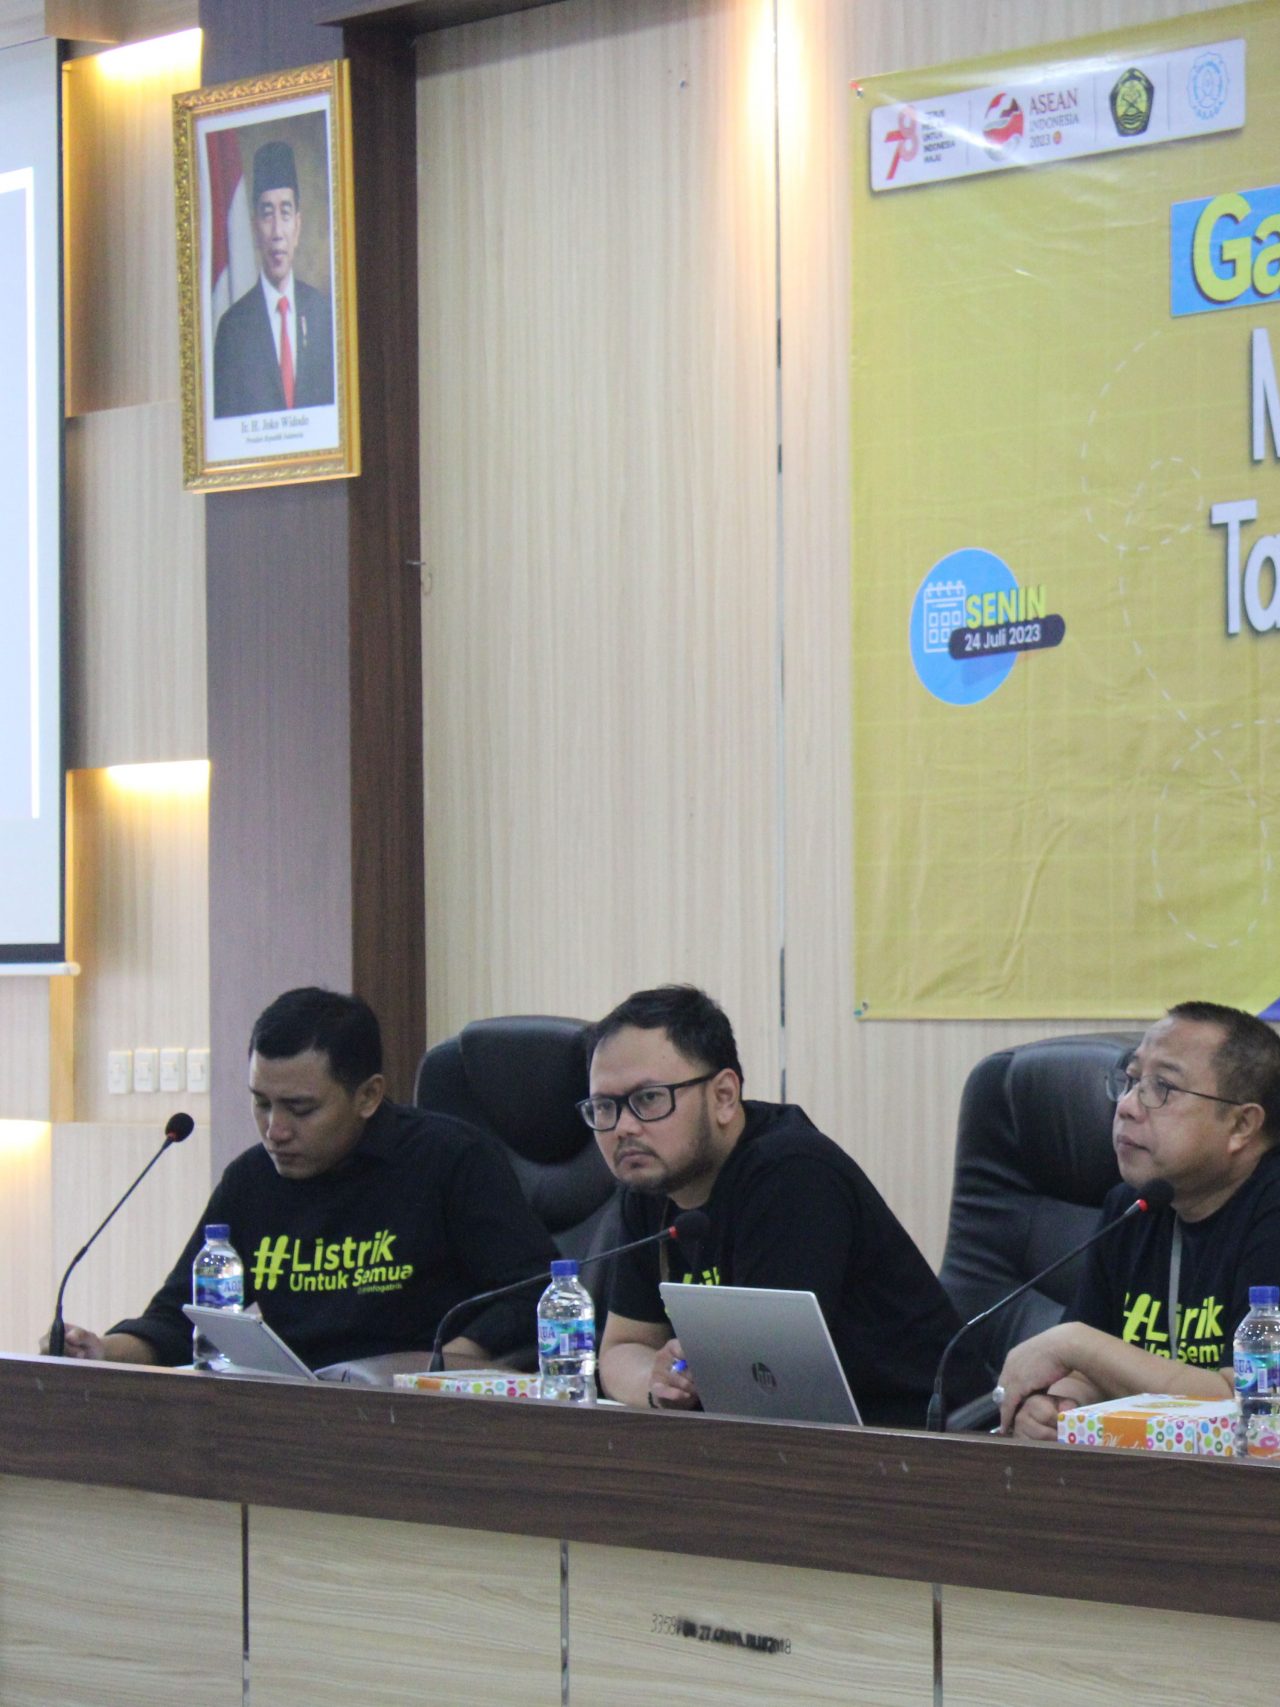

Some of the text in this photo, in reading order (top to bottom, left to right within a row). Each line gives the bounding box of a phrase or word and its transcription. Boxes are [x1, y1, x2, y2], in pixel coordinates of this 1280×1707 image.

[1029, 87, 1079, 115] ASEAN
[1029, 113, 1079, 133] INDONESIA
[1029, 134, 1051, 150] 2023
[965, 583, 1047, 629] SENIN
[964, 623, 1041, 651] 24 Juli 2023
[250, 1229, 396, 1290] #Listrik
[290, 1264, 414, 1292] Untuk Semua
